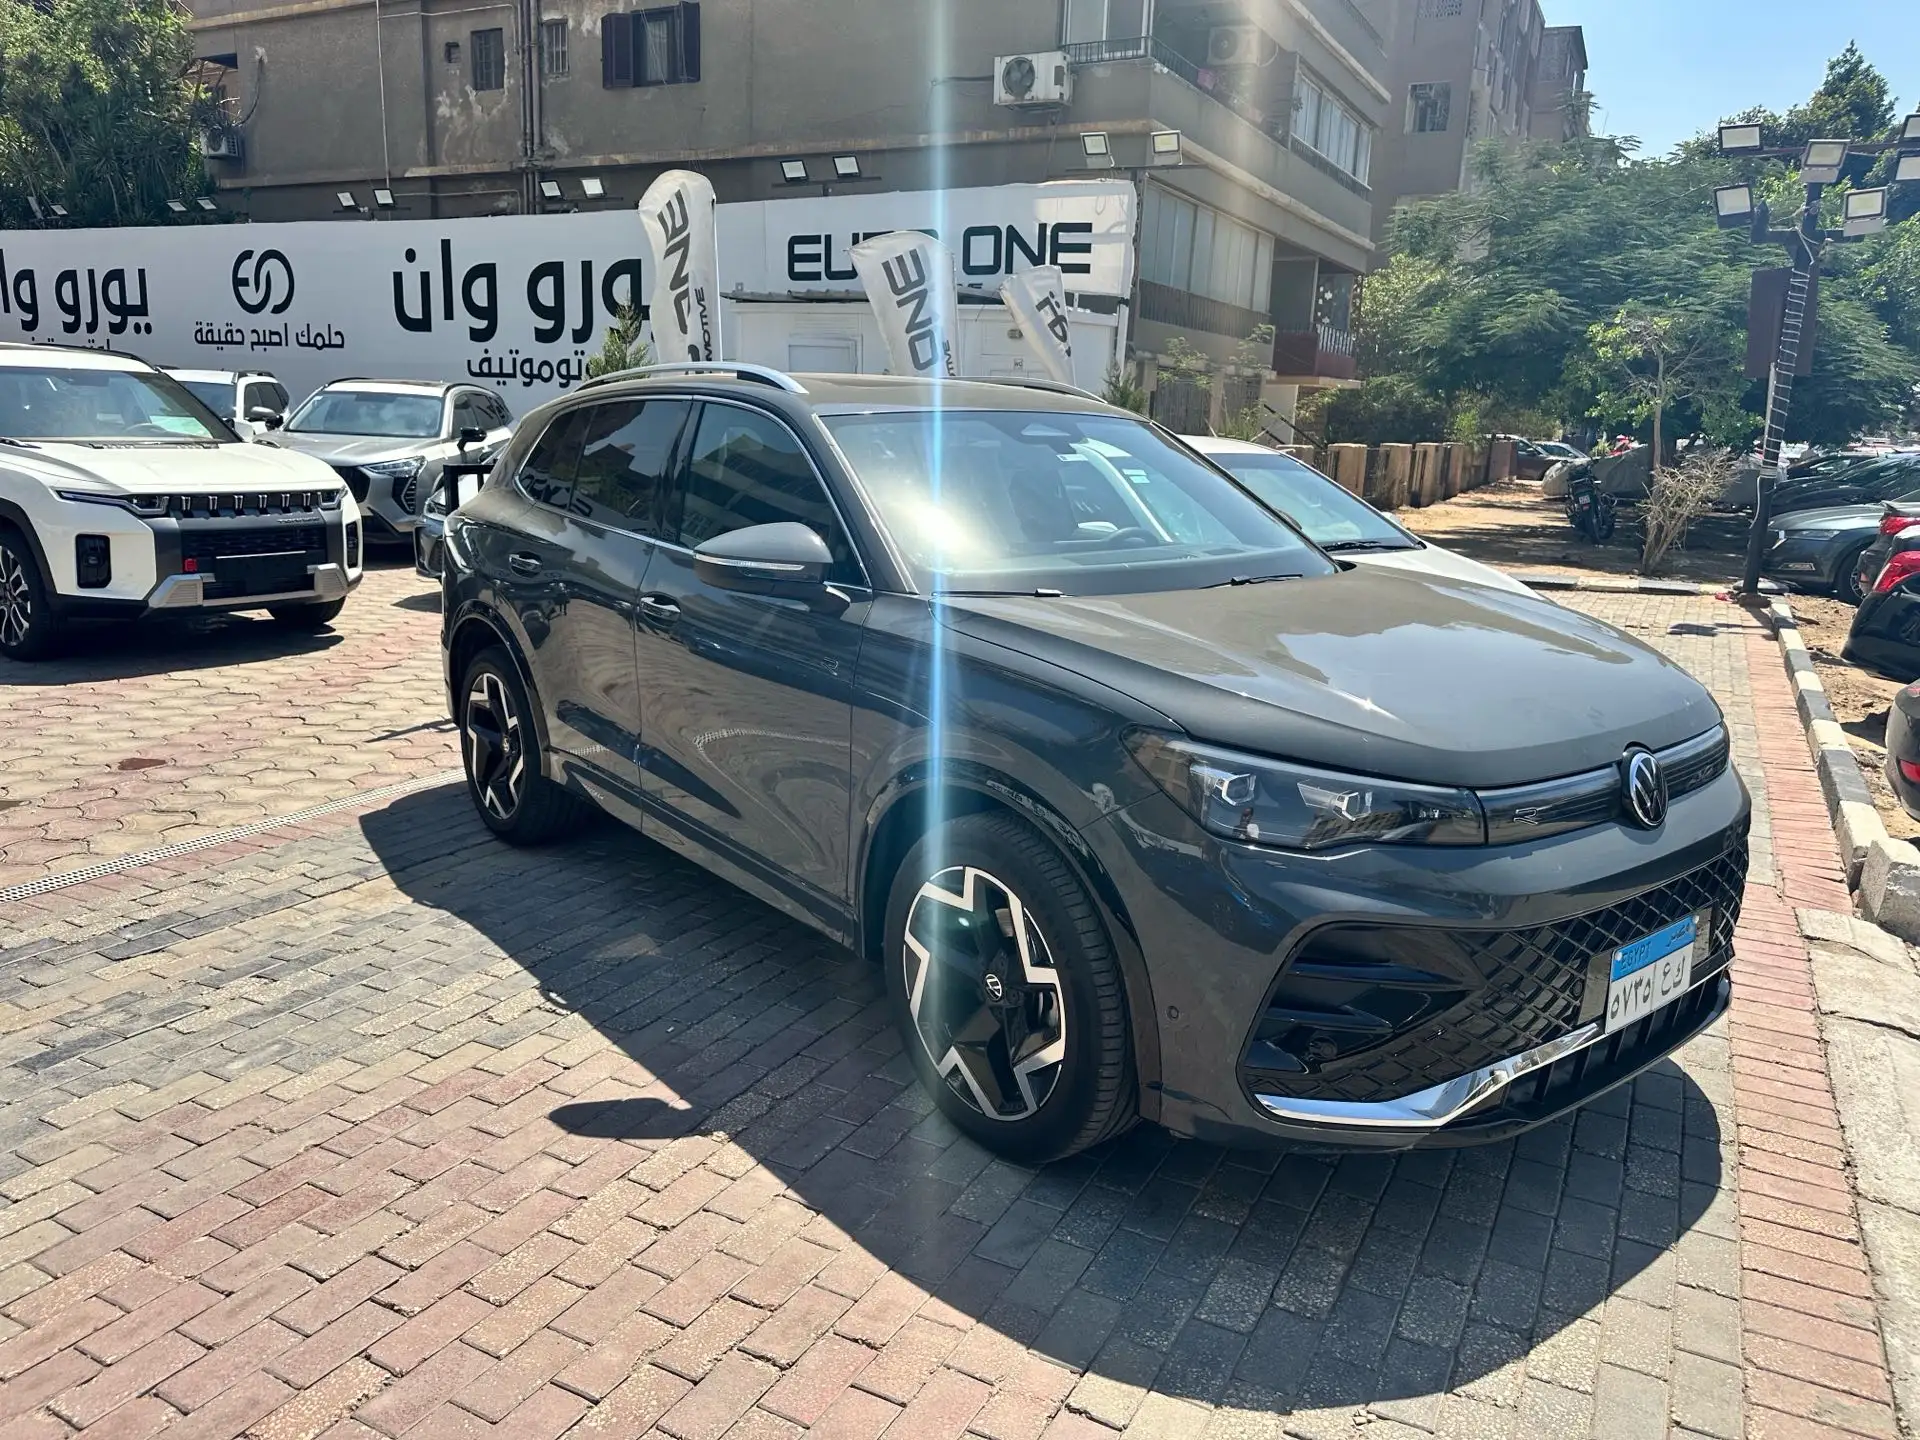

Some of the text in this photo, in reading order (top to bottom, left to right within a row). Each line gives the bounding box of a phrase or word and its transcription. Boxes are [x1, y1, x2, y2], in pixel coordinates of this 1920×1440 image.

[962, 222, 1093, 275] ONE
[0, 249, 152, 334] يورو وا
[392, 238, 499, 343] وان
[881, 248, 939, 371] ONE
[194, 321, 345, 351] حلمك اصبح حقيقة
[1513, 808, 1538, 825] R
[1621, 940, 1651, 969] EGYPT
[1610, 975, 1651, 1020] ٥٧٣٥
